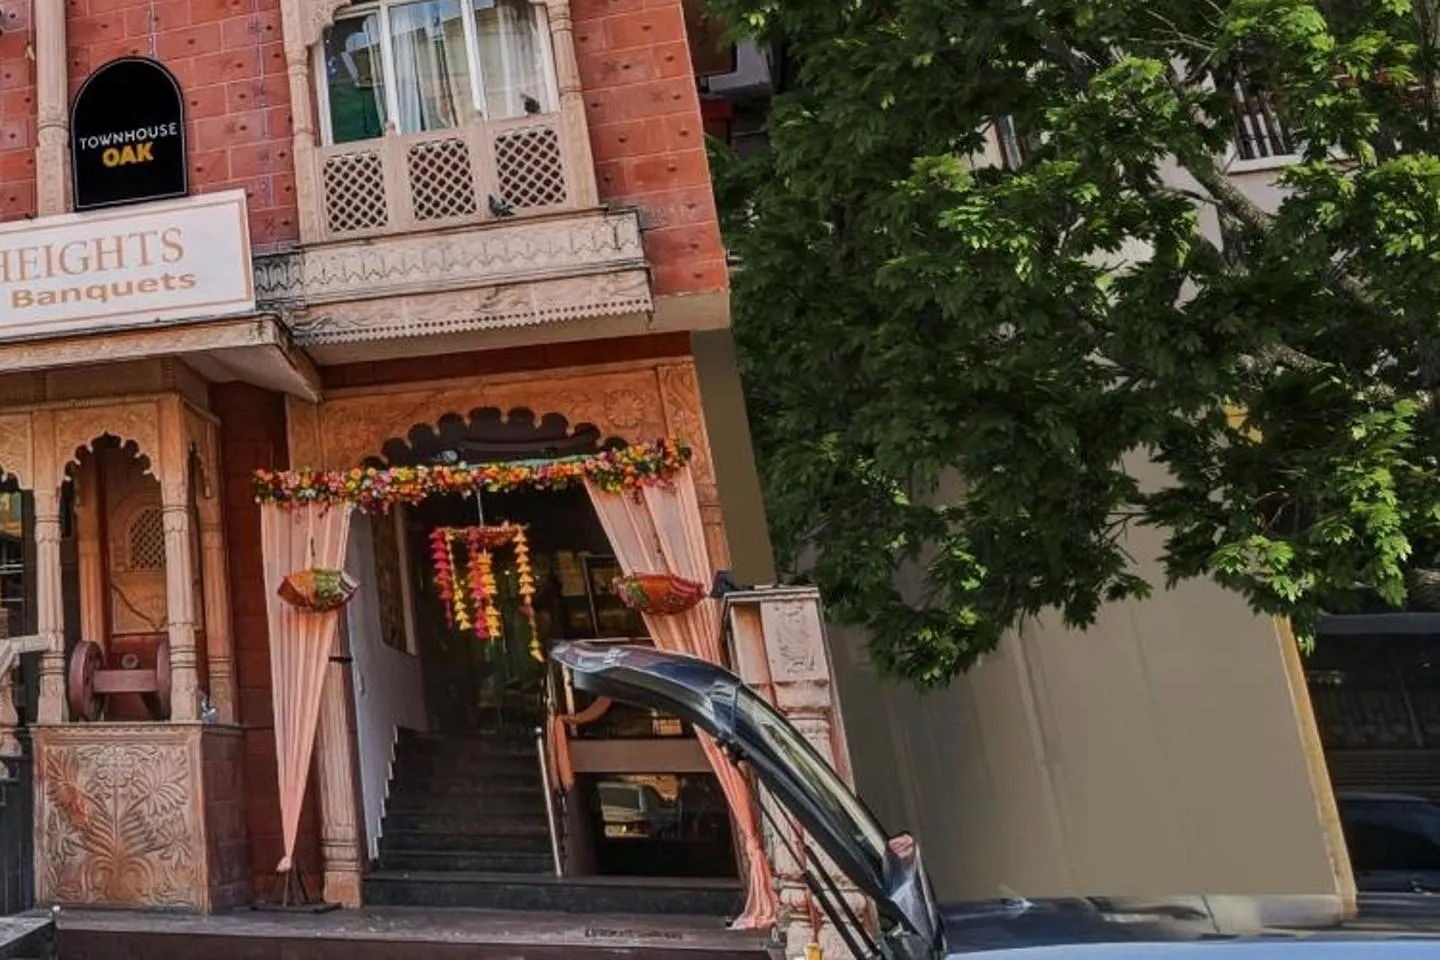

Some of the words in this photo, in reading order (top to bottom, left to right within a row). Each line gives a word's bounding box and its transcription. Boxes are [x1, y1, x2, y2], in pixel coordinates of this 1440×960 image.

[80, 122, 178, 150] TOWNHOUSE
[102, 141, 154, 168] OAK
[11, 271, 197, 309] Banquets
